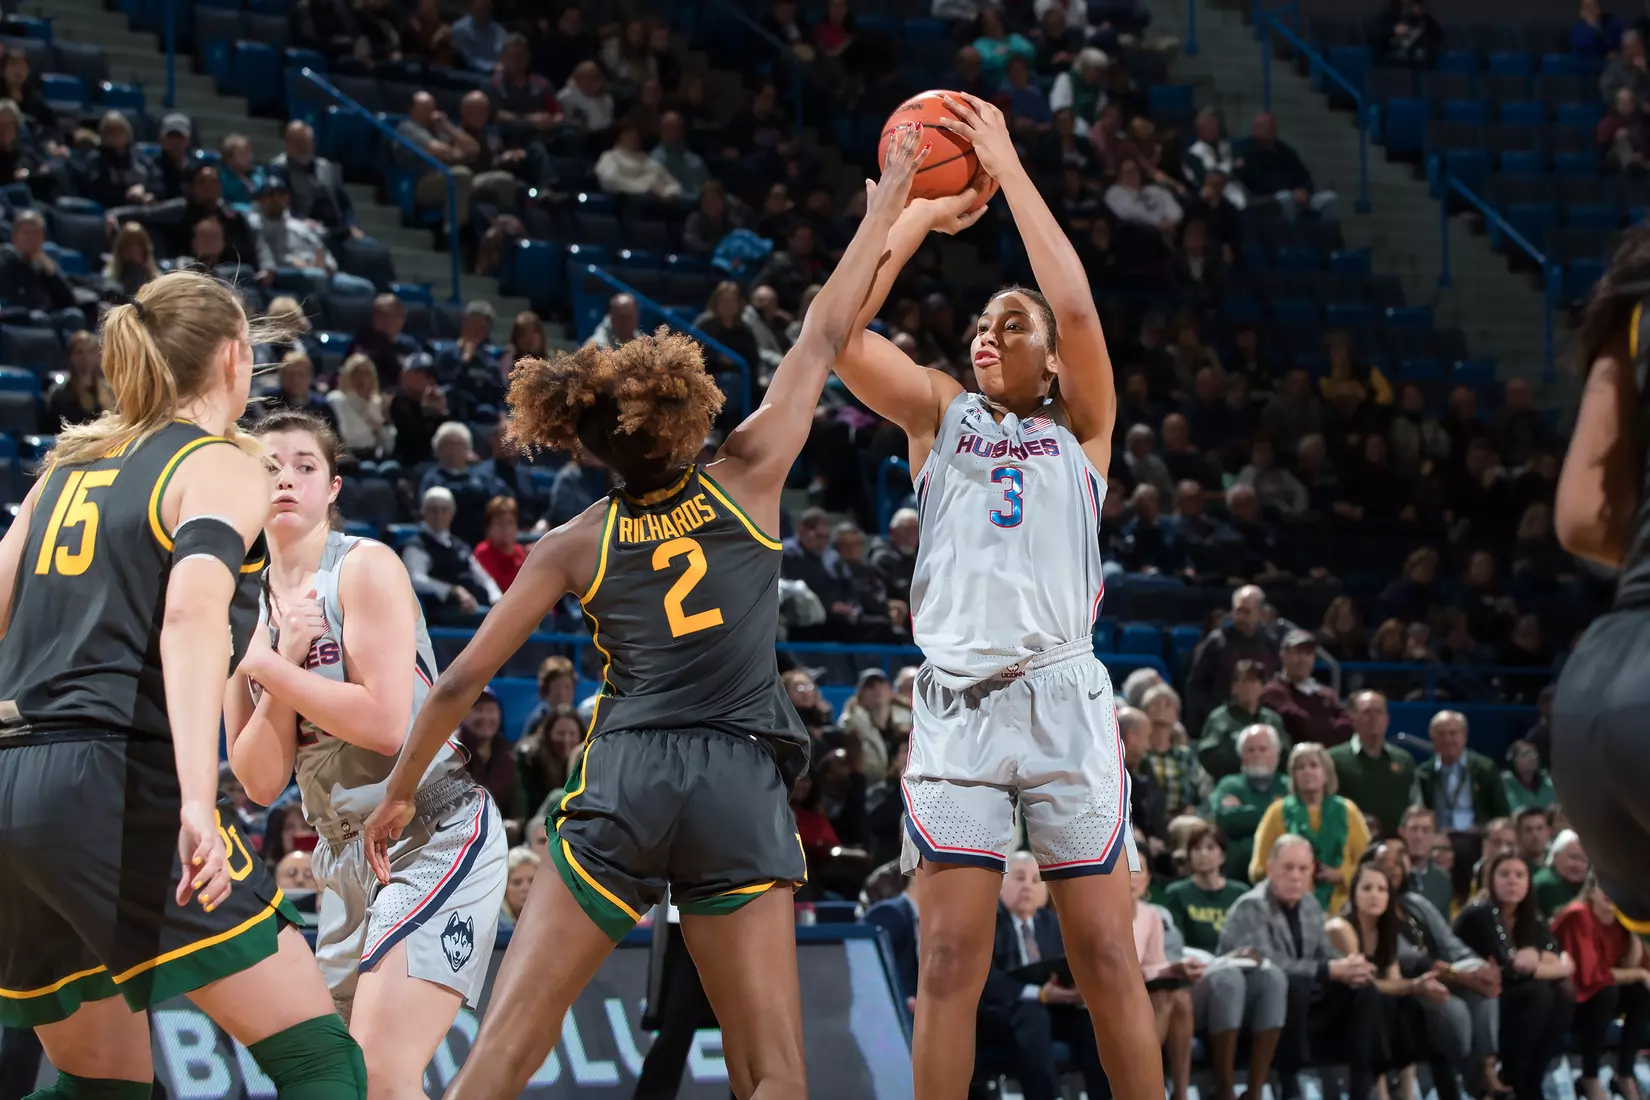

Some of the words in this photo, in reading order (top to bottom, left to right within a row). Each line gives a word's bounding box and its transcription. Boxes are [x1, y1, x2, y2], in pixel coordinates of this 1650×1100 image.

[955, 434, 1061, 461] HUSKIES
[34, 468, 121, 576] 15
[618, 492, 717, 544] RICHARDS
[989, 465, 1024, 529] 3
[651, 536, 725, 639] 2
[1001, 670, 1026, 679] UCONN
